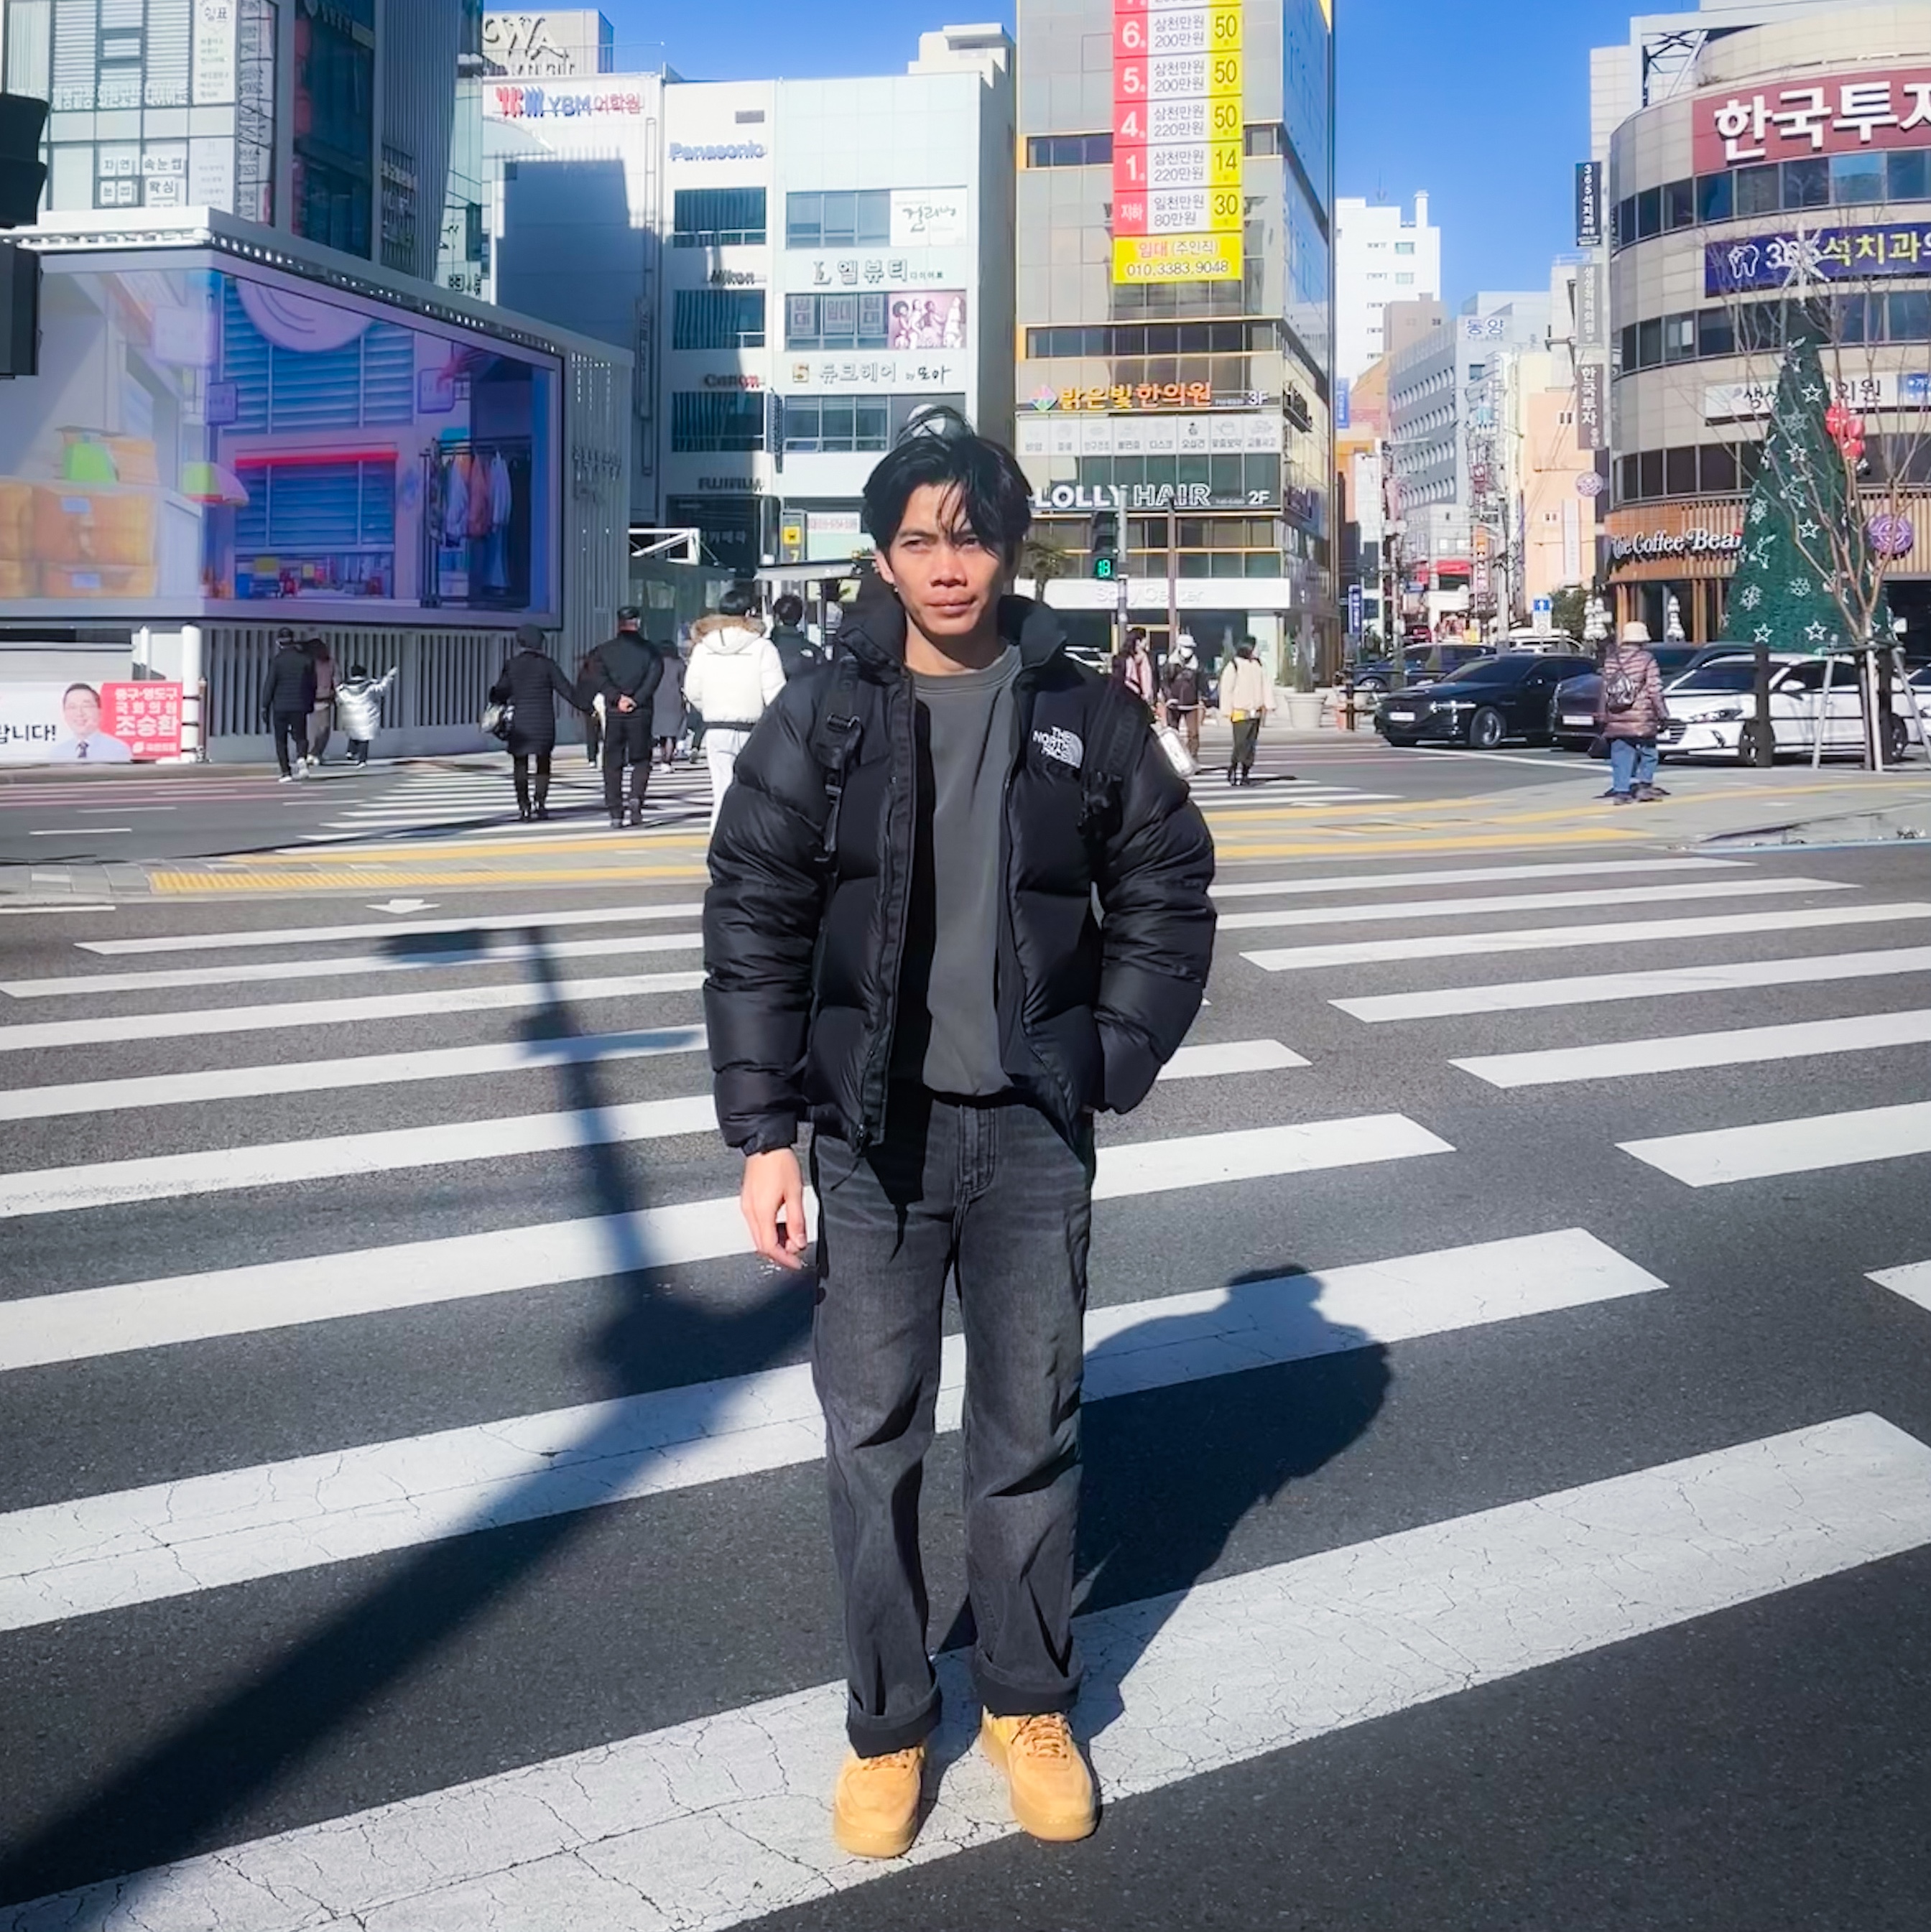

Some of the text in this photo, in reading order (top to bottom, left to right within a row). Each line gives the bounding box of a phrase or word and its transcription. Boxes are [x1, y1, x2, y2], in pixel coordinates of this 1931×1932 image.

[1154, 15, 1204, 32] 삼천만원
[1215, 14, 1237, 39] 50
[1154, 32, 1204, 47] 200만원
[1154, 60, 1204, 77] 삼천만원
[1215, 60, 1237, 83] 50
[1154, 77, 1204, 93] 200만원
[1154, 105, 1204, 121] 삼천만원
[1214, 105, 1237, 129] 50
[1154, 121, 1204, 137] 220만원
[668, 140, 767, 162] Panasonic
[1154, 149, 1204, 166] 삼천만원
[1215, 149, 1237, 171] 14
[1154, 167, 1204, 182] 220만원
[1121, 203, 1144, 221] 지하
[1215, 195, 1238, 215] 30
[1154, 212, 1197, 227] 80만원
[1139, 240, 1218, 259] 임대 (주인직)
[710, 269, 755, 286] Nikon
[838, 259, 908, 284] 엘뷰티
[1126, 261, 1229, 277] 010.3383.9048
[1467, 319, 1504, 335] 동양
[704, 373, 760, 389] Canon
[1247, 390, 1269, 406] 3F
[1581, 366, 1597, 426] 한국투자
[698, 477, 762, 492] FUJIFILM
[1034, 483, 1271, 508] LOLLY HAIR 2F
[1632, 529, 1685, 554] Coffee
[1096, 585, 1204, 605] Soy Ceter
[115, 715, 180, 738] 조승환
[1051, 725, 1071, 744] THE
[1032, 730, 1069, 753] NORTH
